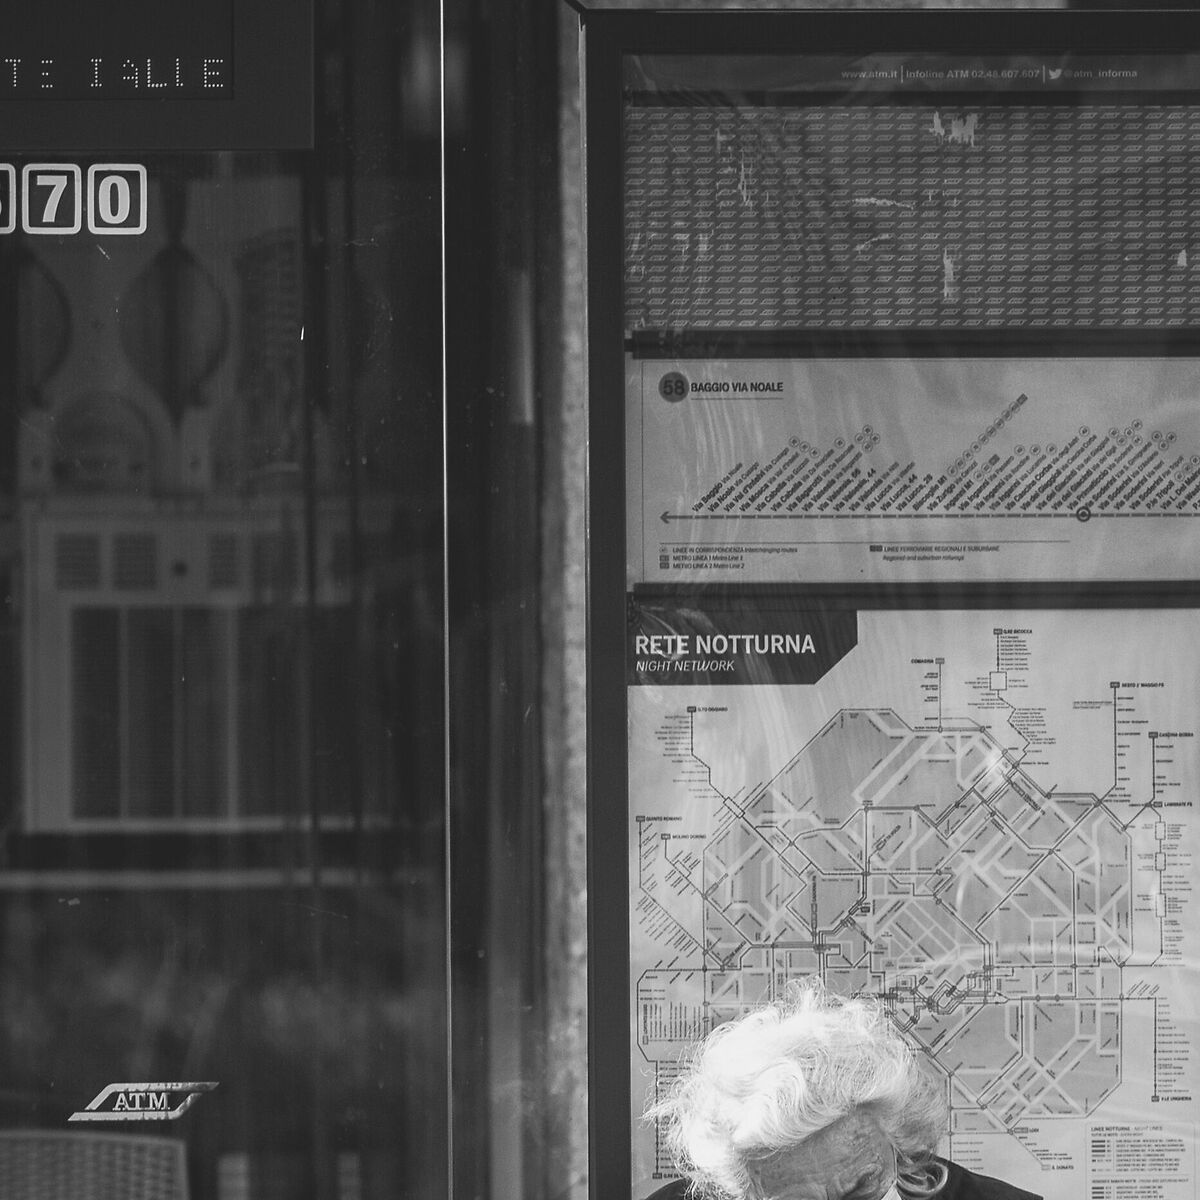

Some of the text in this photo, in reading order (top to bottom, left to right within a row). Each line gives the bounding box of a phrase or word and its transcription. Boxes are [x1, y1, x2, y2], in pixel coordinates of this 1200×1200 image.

[946, 69, 969, 79] ATM
[0, 175, 131, 225] 70
[663, 379, 784, 396] 58 BAGGIO VIA NOALE
[635, 634, 816, 656] RETE NOTTURNA
[636, 659, 735, 672] NIGHT NETWORK
[112, 1092, 171, 1111] ATM
